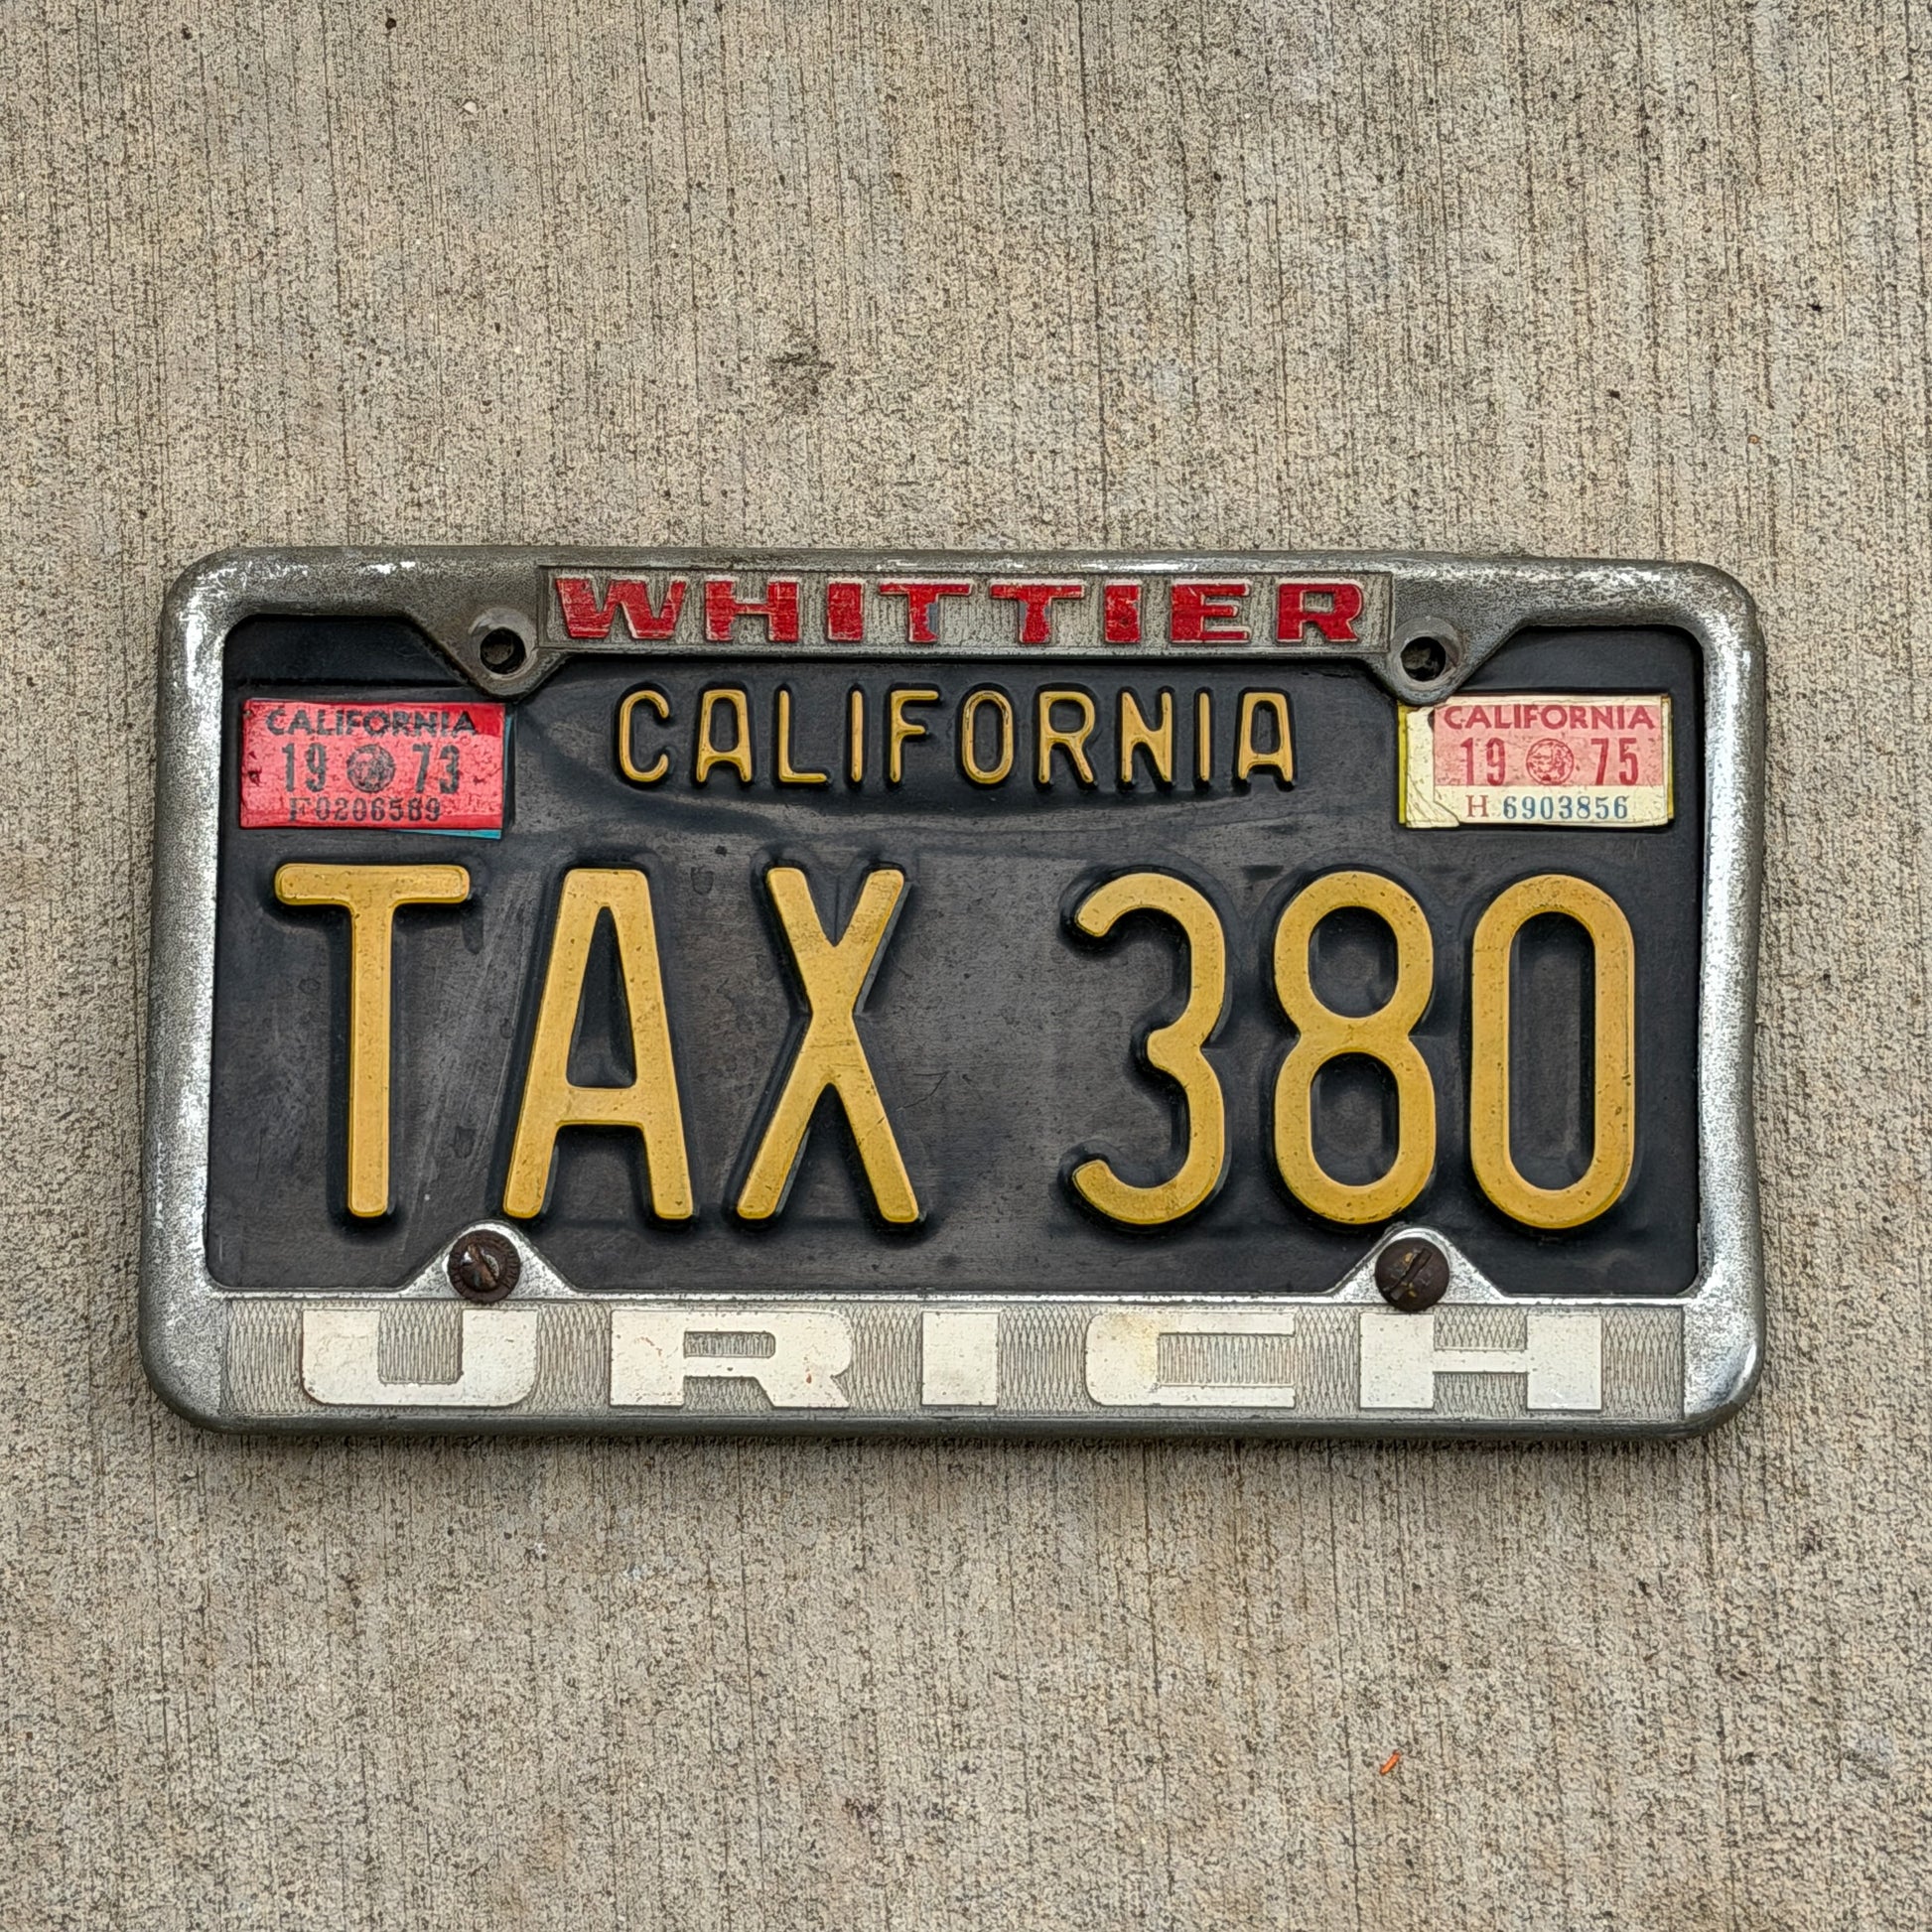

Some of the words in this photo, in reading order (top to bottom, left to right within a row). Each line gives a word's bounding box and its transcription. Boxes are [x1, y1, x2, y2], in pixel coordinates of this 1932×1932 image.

[556, 577, 1366, 644] WHITTIER
[265, 708, 477, 737] CALIFORNIA
[619, 688, 1296, 784] CALIFORNIA
[1444, 704, 1655, 730] CALIFORNIA
[281, 743, 327, 793] 19
[412, 745, 460, 794] 73
[1460, 737, 1506, 786] 19
[1590, 738, 1638, 786] 75
[1466, 795, 1488, 817] H
[1502, 795, 1628, 820] 6903856
[274, 863, 919, 1224] TAX
[1072, 870, 1636, 1230] 380
[301, 1309, 1603, 1411] URICH
